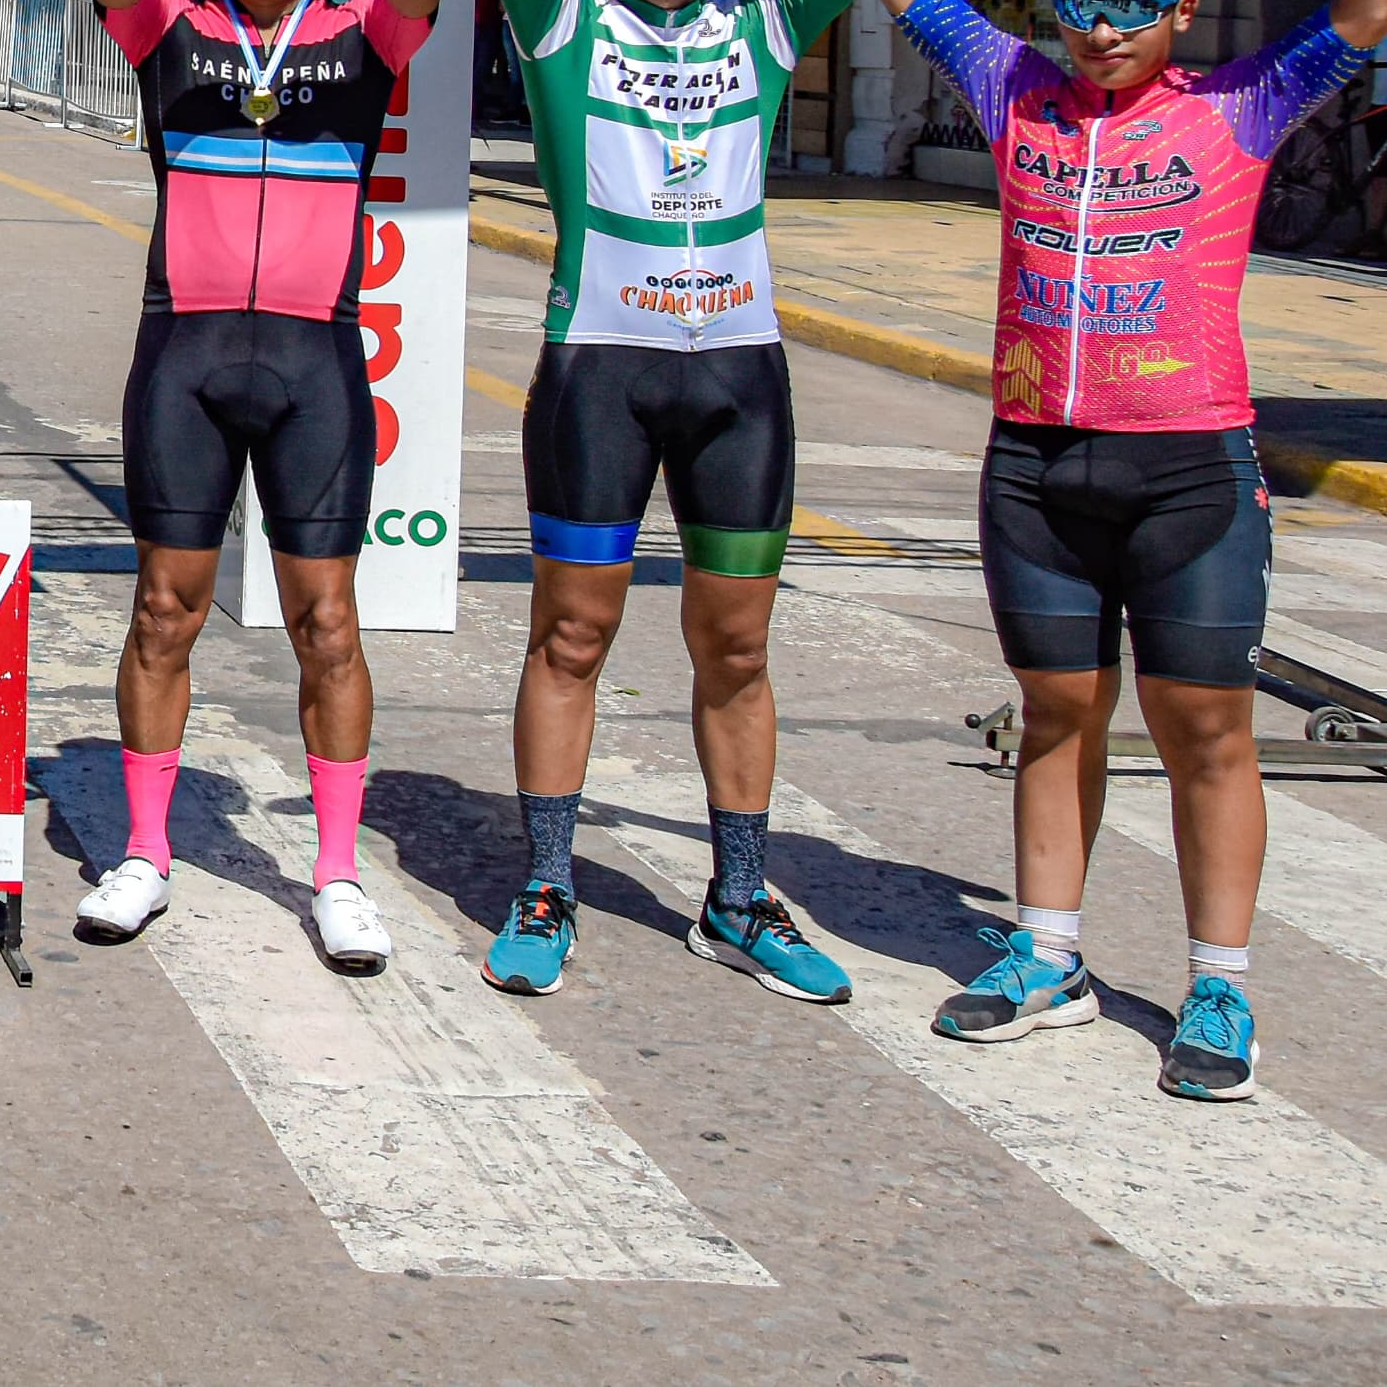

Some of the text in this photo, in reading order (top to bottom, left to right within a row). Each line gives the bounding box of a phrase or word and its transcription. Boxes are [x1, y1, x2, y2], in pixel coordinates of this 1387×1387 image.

[190, 51, 347, 85] SAÉN PEÑA
[220, 83, 313, 106] CCO
[1013, 143, 1196, 190] CAPELLA
[652, 199, 723, 212] DEPORTE
[1014, 266, 1166, 316] NUÑEZ
